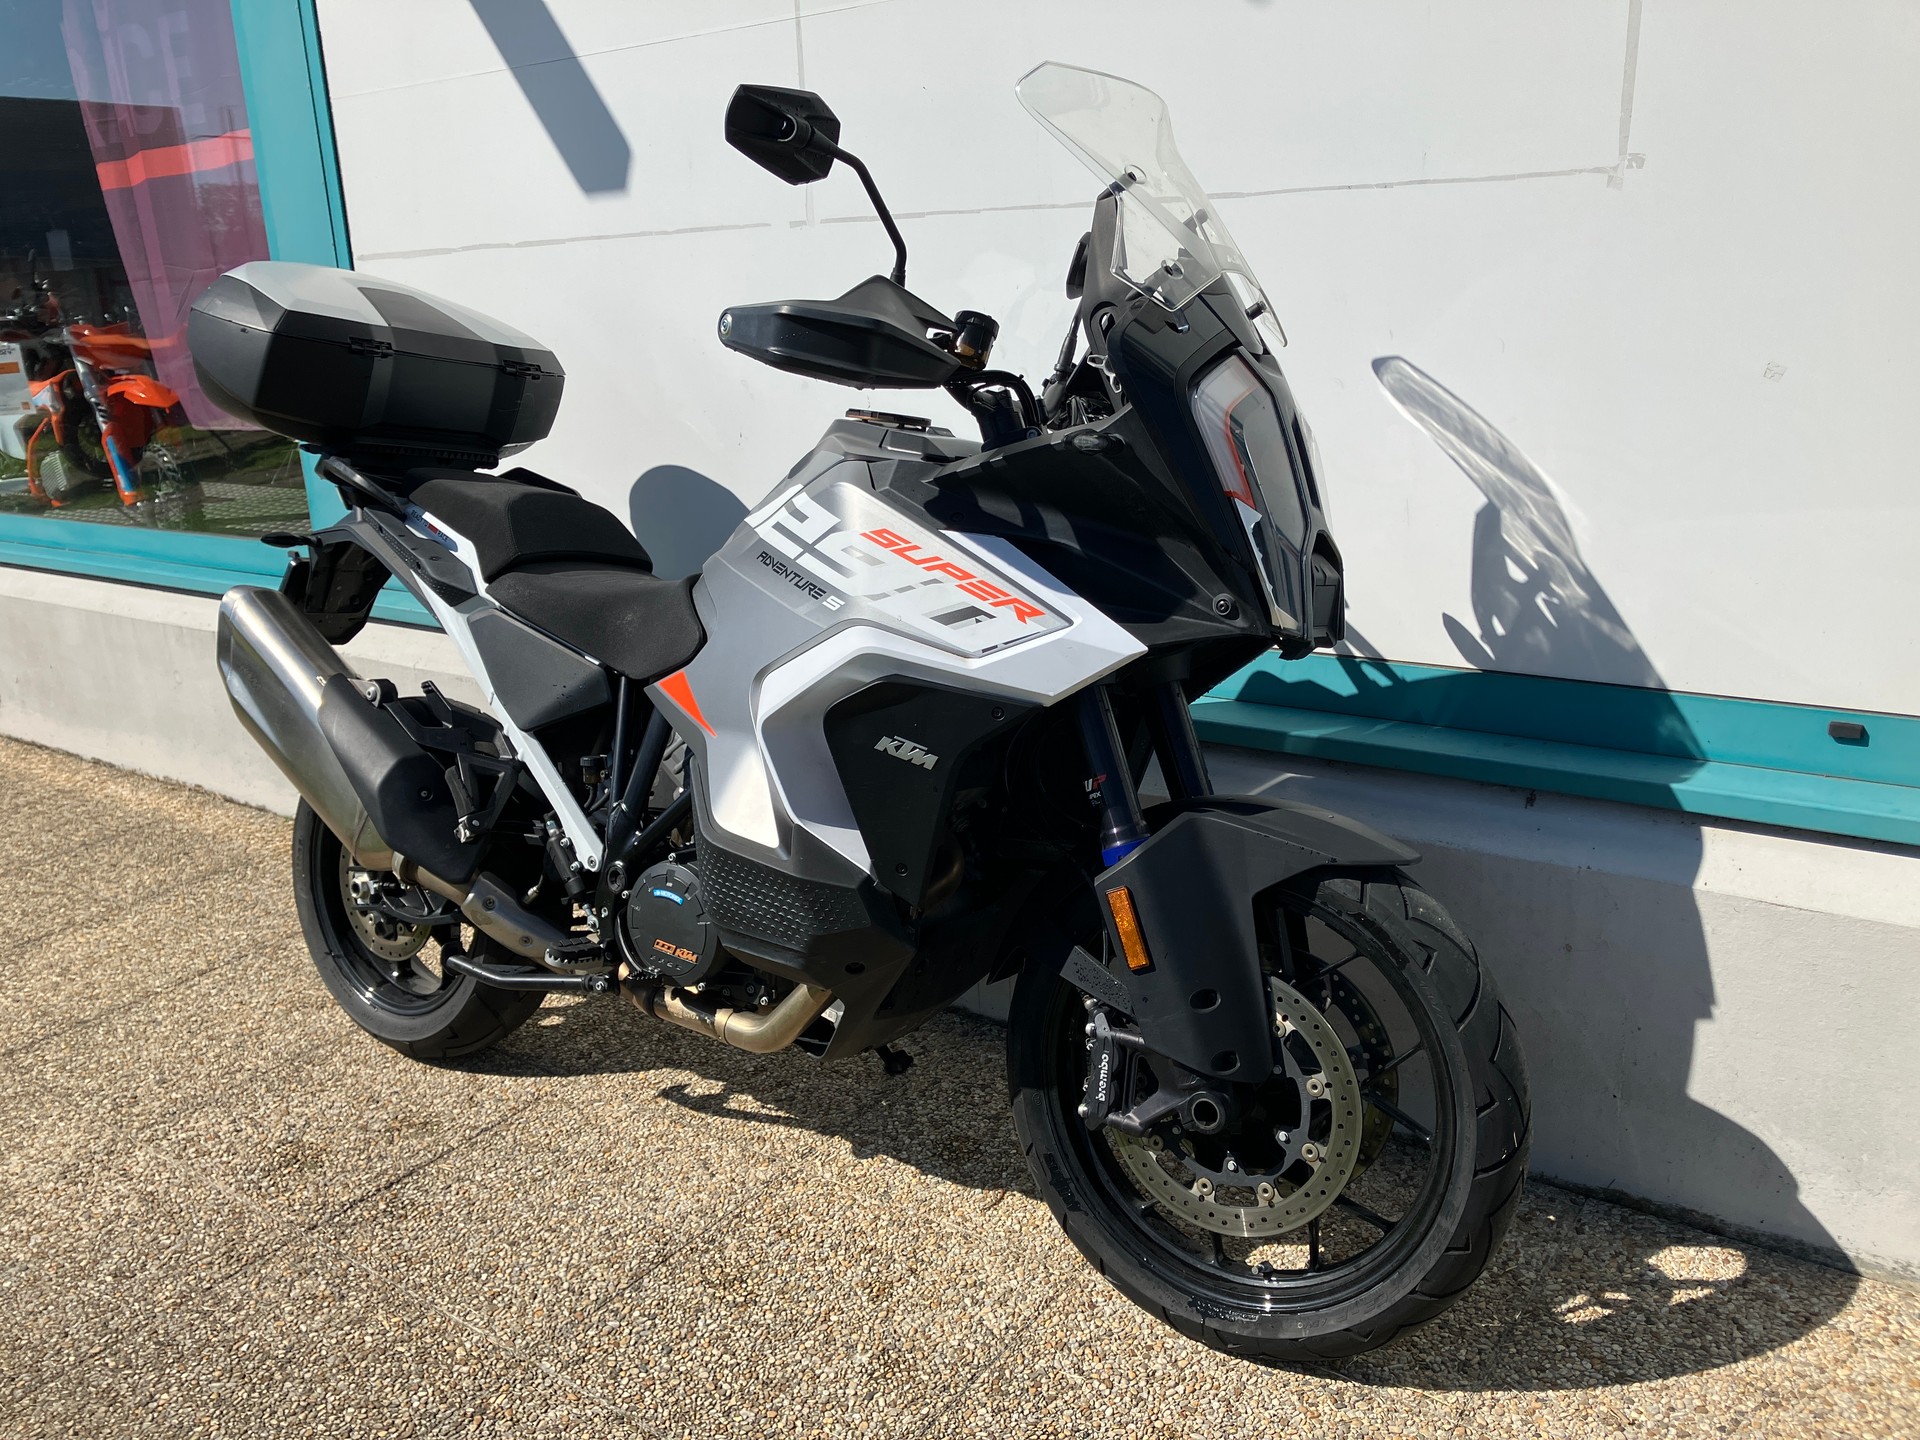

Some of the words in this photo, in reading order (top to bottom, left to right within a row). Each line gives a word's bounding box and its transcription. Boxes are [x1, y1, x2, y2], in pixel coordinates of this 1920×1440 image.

[756, 550, 828, 601] ADVENTURE
[821, 595, 846, 611] S
[859, 528, 1047, 625] SUPER
[873, 735, 939, 771] KTM
[675, 947, 699, 964] KTM
[1095, 1053, 1110, 1102] brembo
